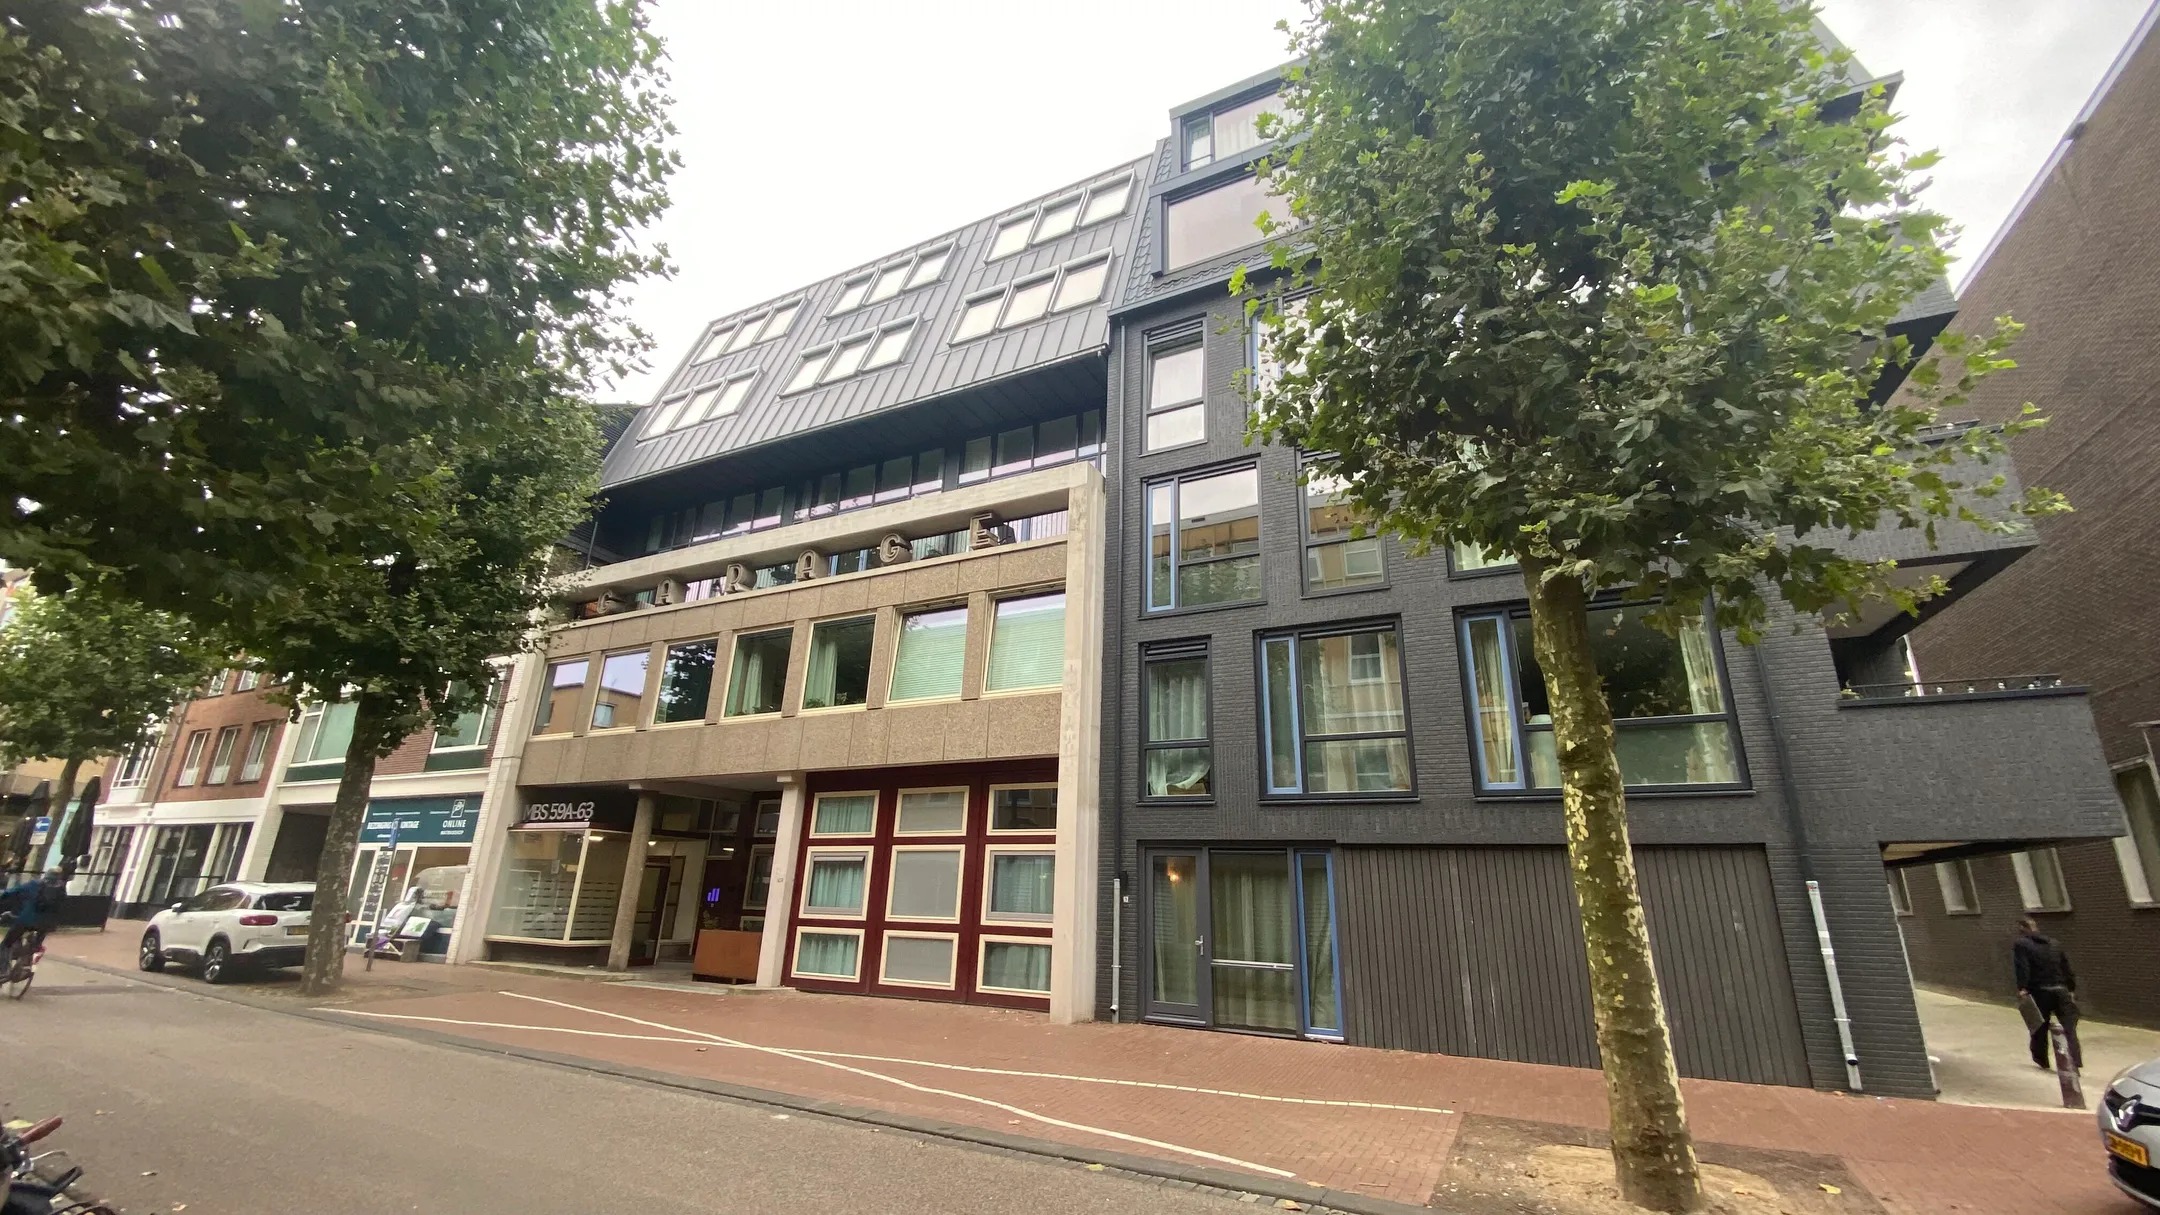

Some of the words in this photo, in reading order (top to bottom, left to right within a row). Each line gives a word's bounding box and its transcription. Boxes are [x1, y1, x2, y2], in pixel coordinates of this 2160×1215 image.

[597, 513, 997, 615] GARAGE
[523, 803, 549, 821] MBS
[549, 801, 595, 821] 59A-63
[442, 819, 467, 829] ONLINE
